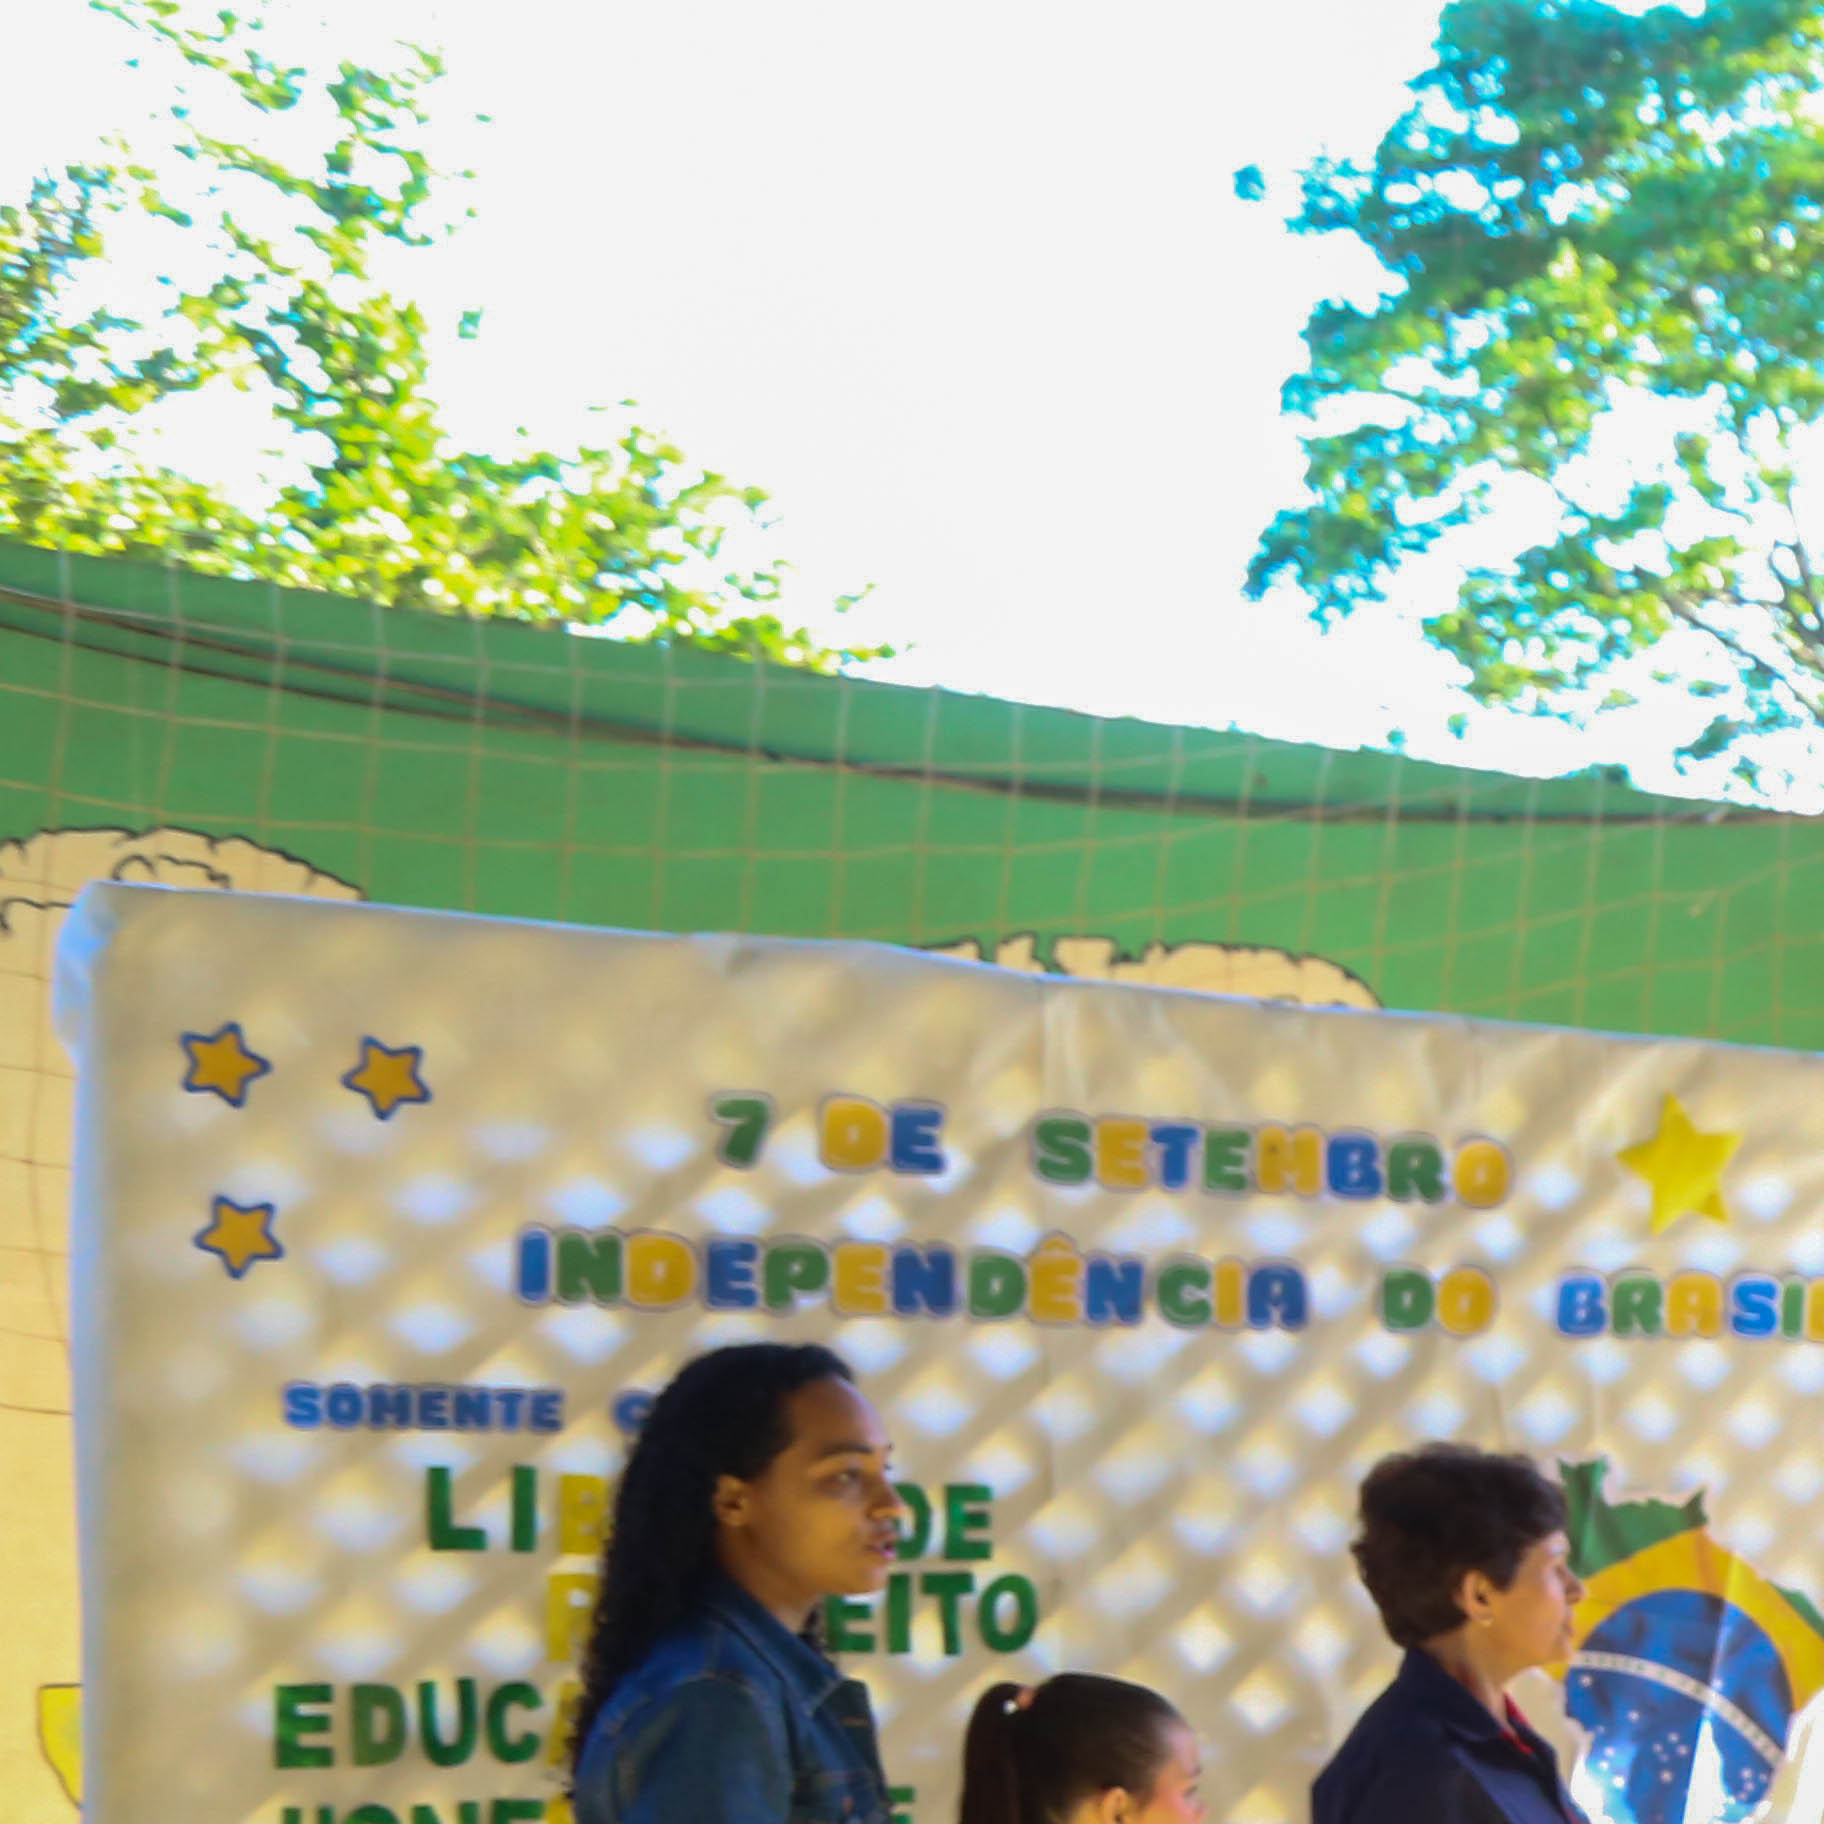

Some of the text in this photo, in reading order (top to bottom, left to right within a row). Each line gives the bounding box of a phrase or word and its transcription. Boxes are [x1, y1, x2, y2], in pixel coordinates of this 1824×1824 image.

[709, 1091, 1514, 1208] 7 DE SETEMBRO
[514, 1223, 1311, 1331] INDEPENDÊNCIA
[1380, 1264, 1497, 1336] DO
[282, 1380, 567, 1434] SOMENTE
